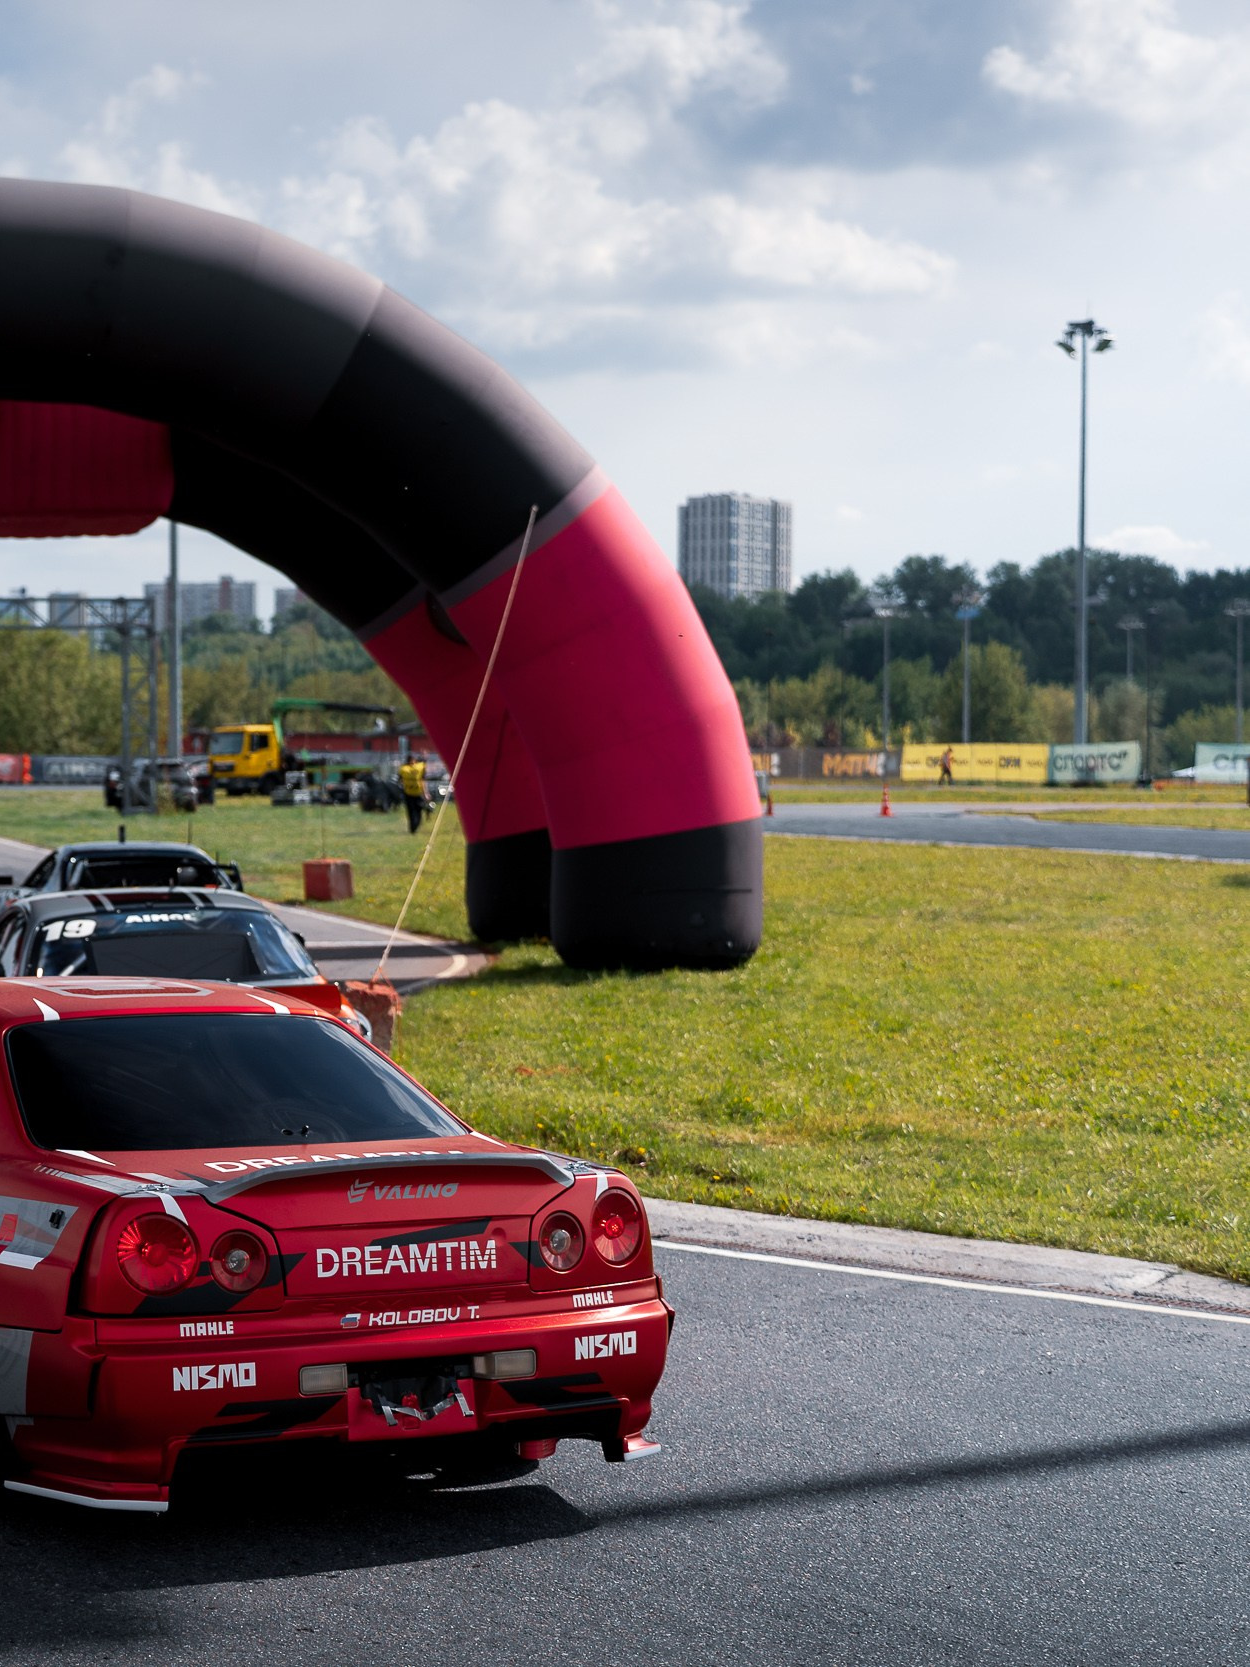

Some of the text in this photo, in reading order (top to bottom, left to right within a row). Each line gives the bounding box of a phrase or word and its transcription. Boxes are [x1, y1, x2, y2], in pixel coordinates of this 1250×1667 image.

[41, 919, 97, 942] 19
[374, 1182, 459, 1201] VALINO
[316, 1239, 498, 1278] DREAMTIM
[572, 1290, 614, 1308] MAHLE
[368, 1305, 481, 1327] KOLOBOV T.
[179, 1321, 234, 1337] MAHLE
[574, 1330, 637, 1361] NISMO
[172, 1362, 257, 1391] NISMO
